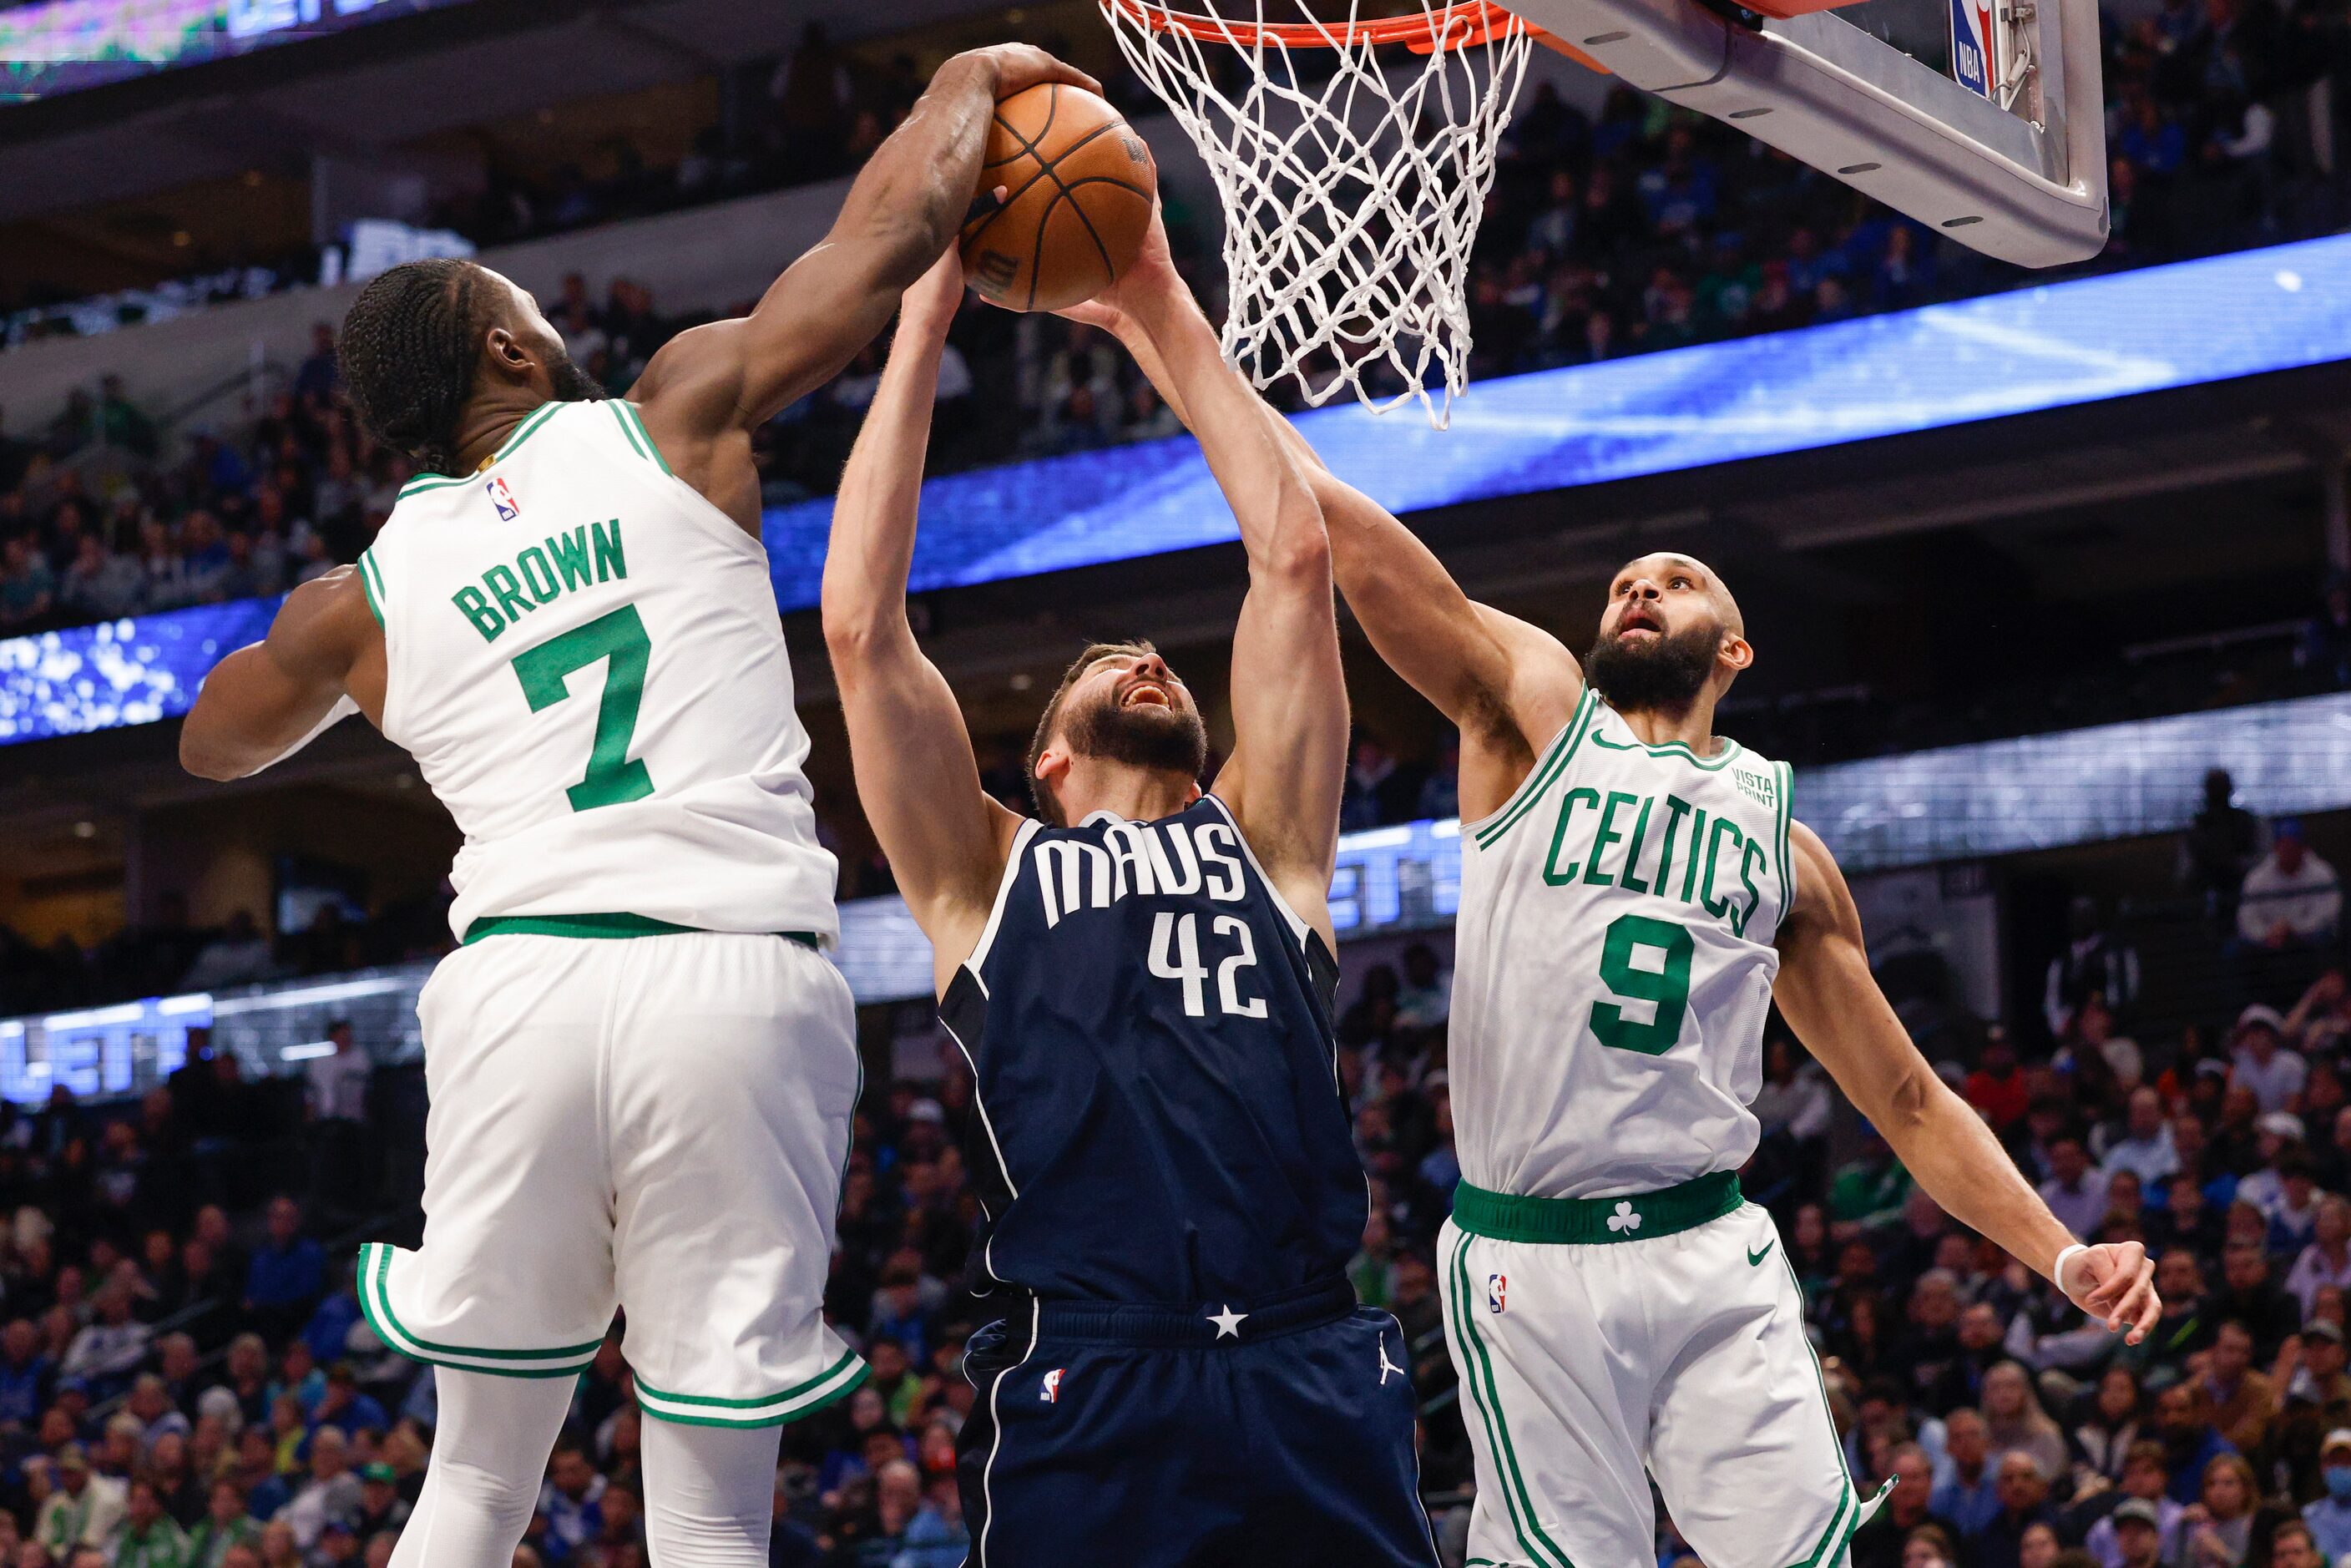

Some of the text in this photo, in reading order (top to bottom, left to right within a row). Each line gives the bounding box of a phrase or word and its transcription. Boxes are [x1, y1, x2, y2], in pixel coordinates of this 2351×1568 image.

[1959, 40, 1979, 83] NBA
[451, 518, 627, 644] BROWN
[510, 603, 655, 812] 7
[1731, 766, 1773, 795] VISTA
[1736, 781, 1774, 808] PRINT
[1542, 787, 1767, 939] CELTICS
[1147, 912, 1269, 1019] 42
[1589, 913, 1696, 1056] 9
